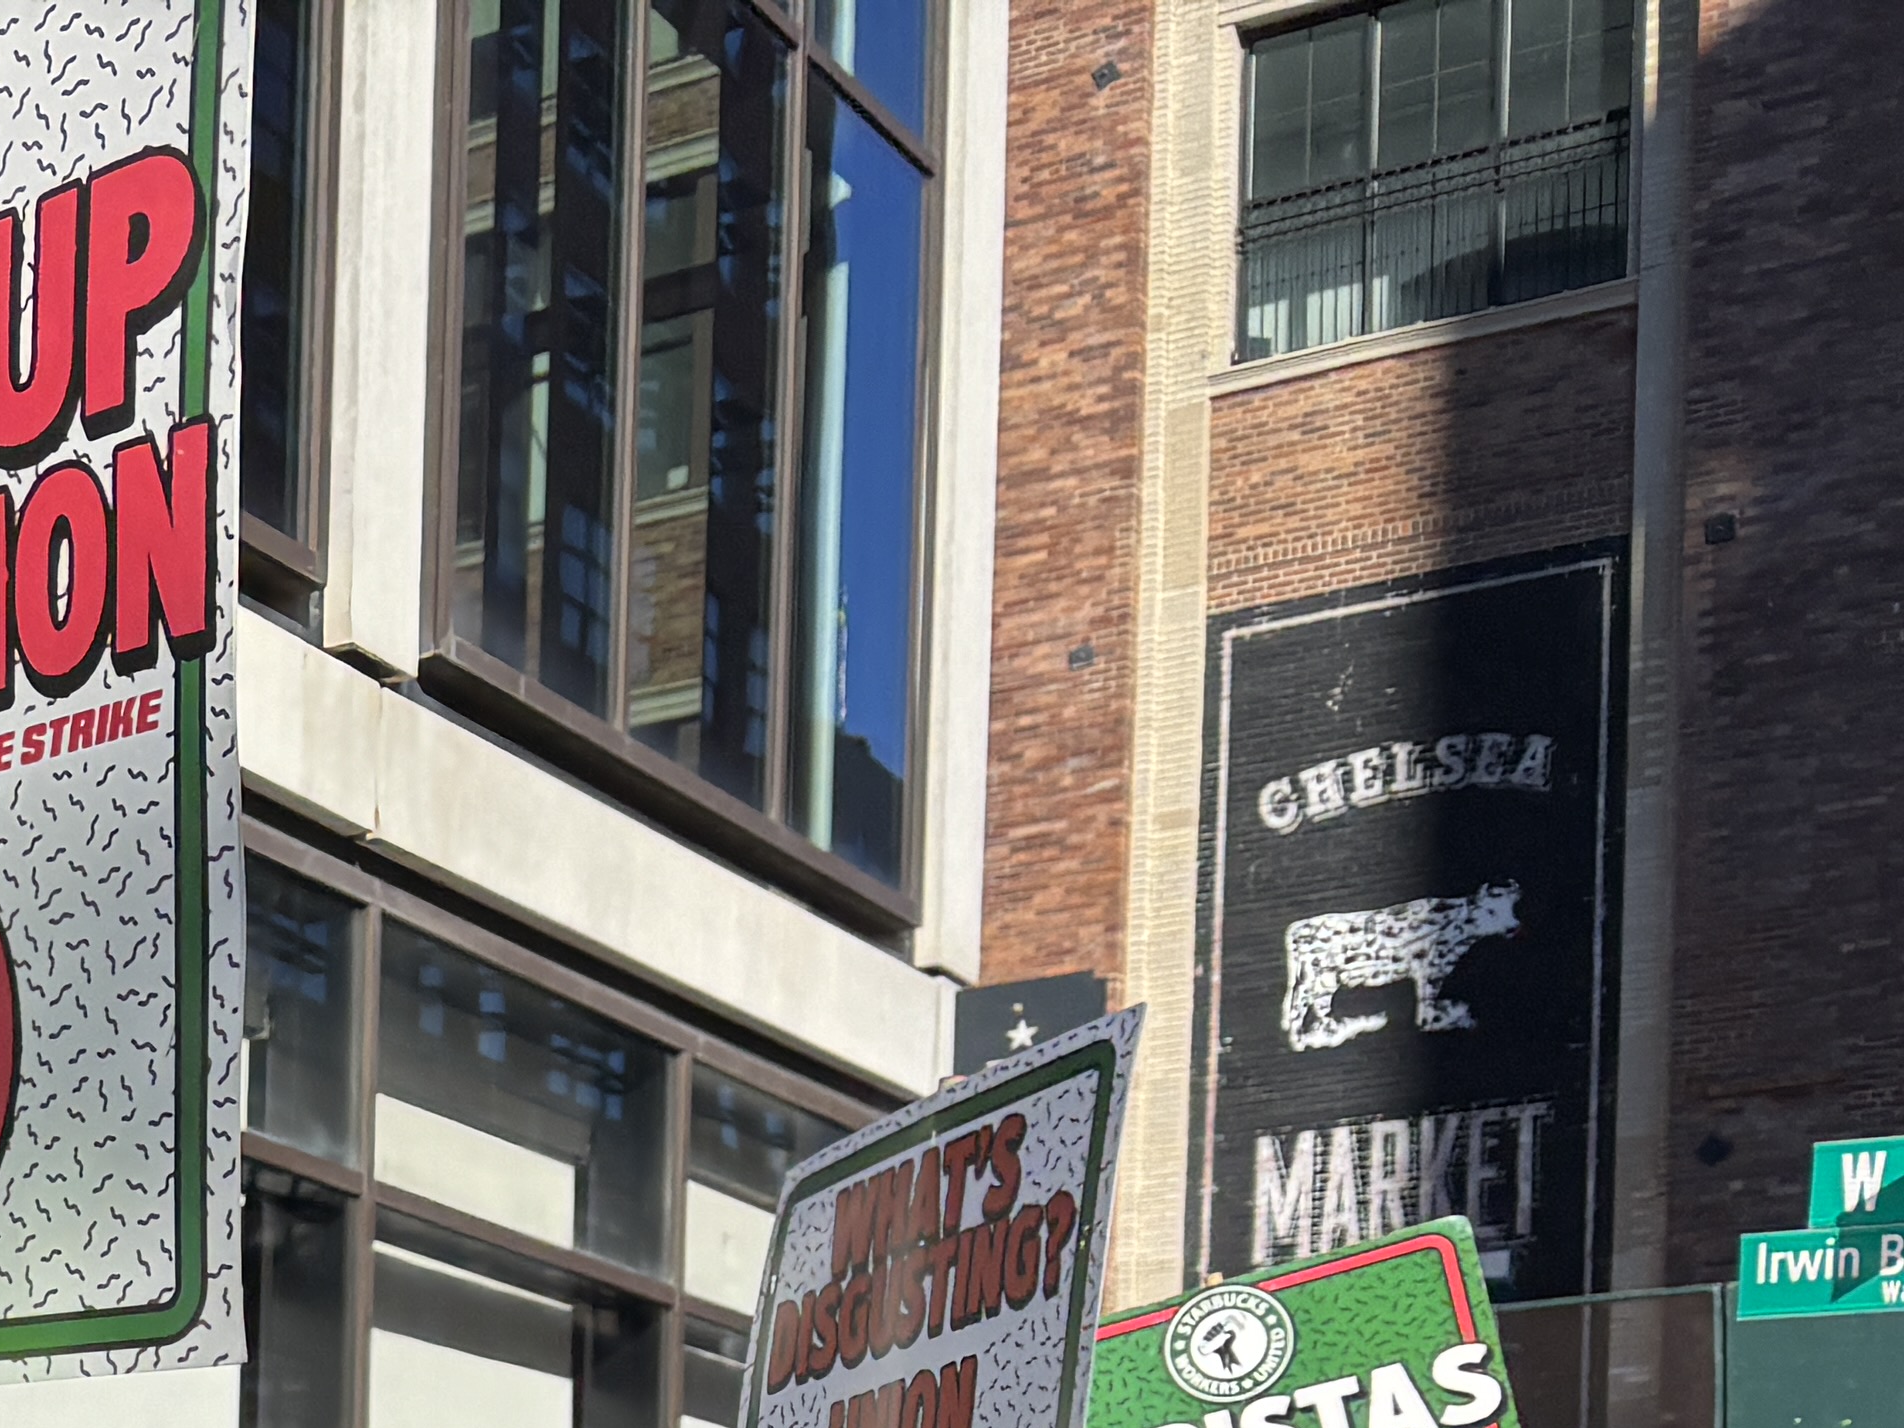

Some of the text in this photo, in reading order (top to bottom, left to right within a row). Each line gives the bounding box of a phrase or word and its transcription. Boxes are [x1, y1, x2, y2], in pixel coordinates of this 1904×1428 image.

[20, 690, 165, 768] STRIKE
[1257, 732, 1554, 834] CHELSEA
[830, 1112, 1027, 1283] WHAT'S
[1251, 1101, 1552, 1265] MARKET
[1841, 1150, 1887, 1212] W
[766, 1190, 1077, 1396] DISGUSTING?
[1756, 1237, 1860, 1285] Irwin
[1881, 1279, 1904, 1305] W
[1176, 1293, 1270, 1336] STARBUCKS
